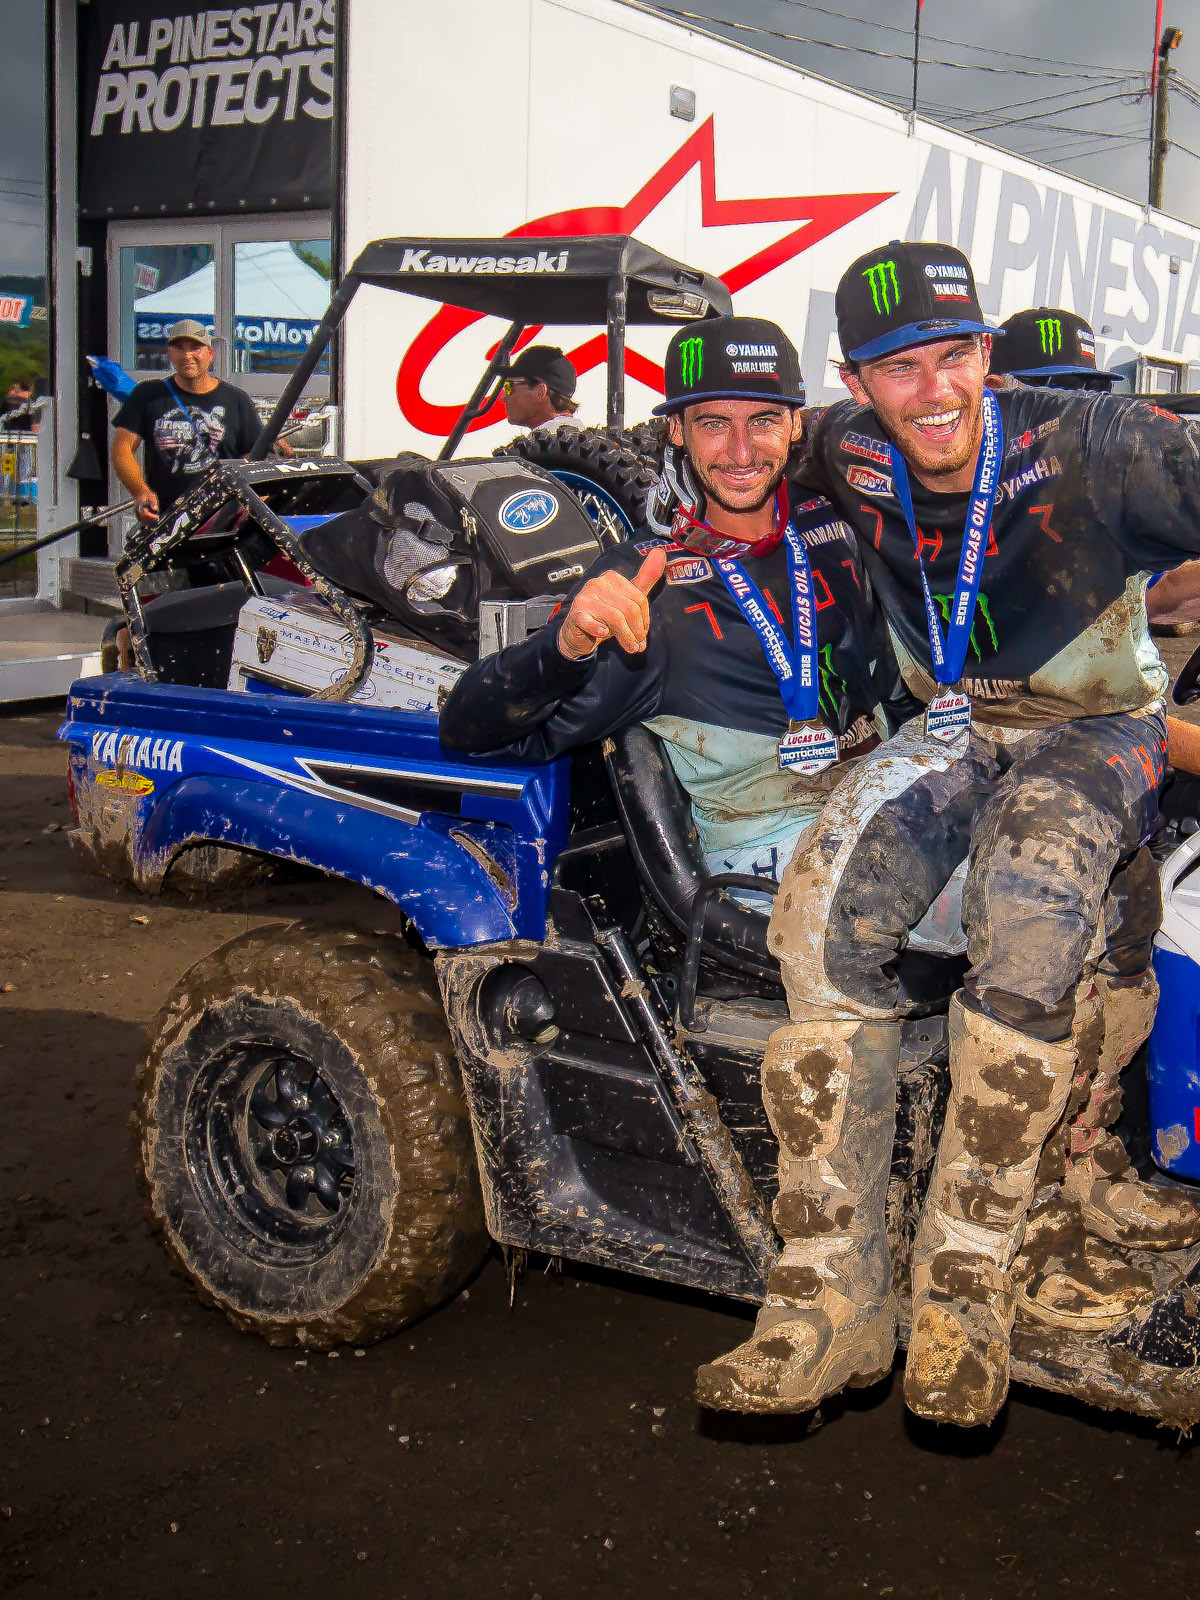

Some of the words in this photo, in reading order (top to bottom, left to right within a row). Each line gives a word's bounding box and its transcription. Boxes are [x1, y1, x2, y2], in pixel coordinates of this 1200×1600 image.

[101, 0, 335, 71] ALPINESTARS
[90, 48, 334, 136] PROTECTS
[399, 248, 569, 273] Kawasaki
[935, 265, 968, 280] YAMAHA
[738, 344, 778, 357] YAMAHA
[731, 361, 775, 373] YAMALUBE
[979, 396, 993, 494] MOTOCROSS
[1002, 456, 1063, 501] YAMAHA
[800, 520, 847, 548] YAMAH
[962, 527, 982, 585] LUCAS
[669, 561, 705, 580] 100%
[797, 596, 812, 648] LUCAS
[955, 590, 970, 627] 2018
[281, 630, 337, 653] MATRIX
[745, 598, 794, 680] MOTOCROSS
[801, 654, 812, 687] 2018
[935, 699, 954, 710] LUCAS
[955, 697, 964, 707] OIL
[928, 712, 970, 725] MOTOCROSS
[92, 730, 185, 773] YAMAHA
[780, 746, 836, 760] MOTOCROSS
[787, 734, 813, 745] LUCAS
[814, 733, 827, 742] OIL
